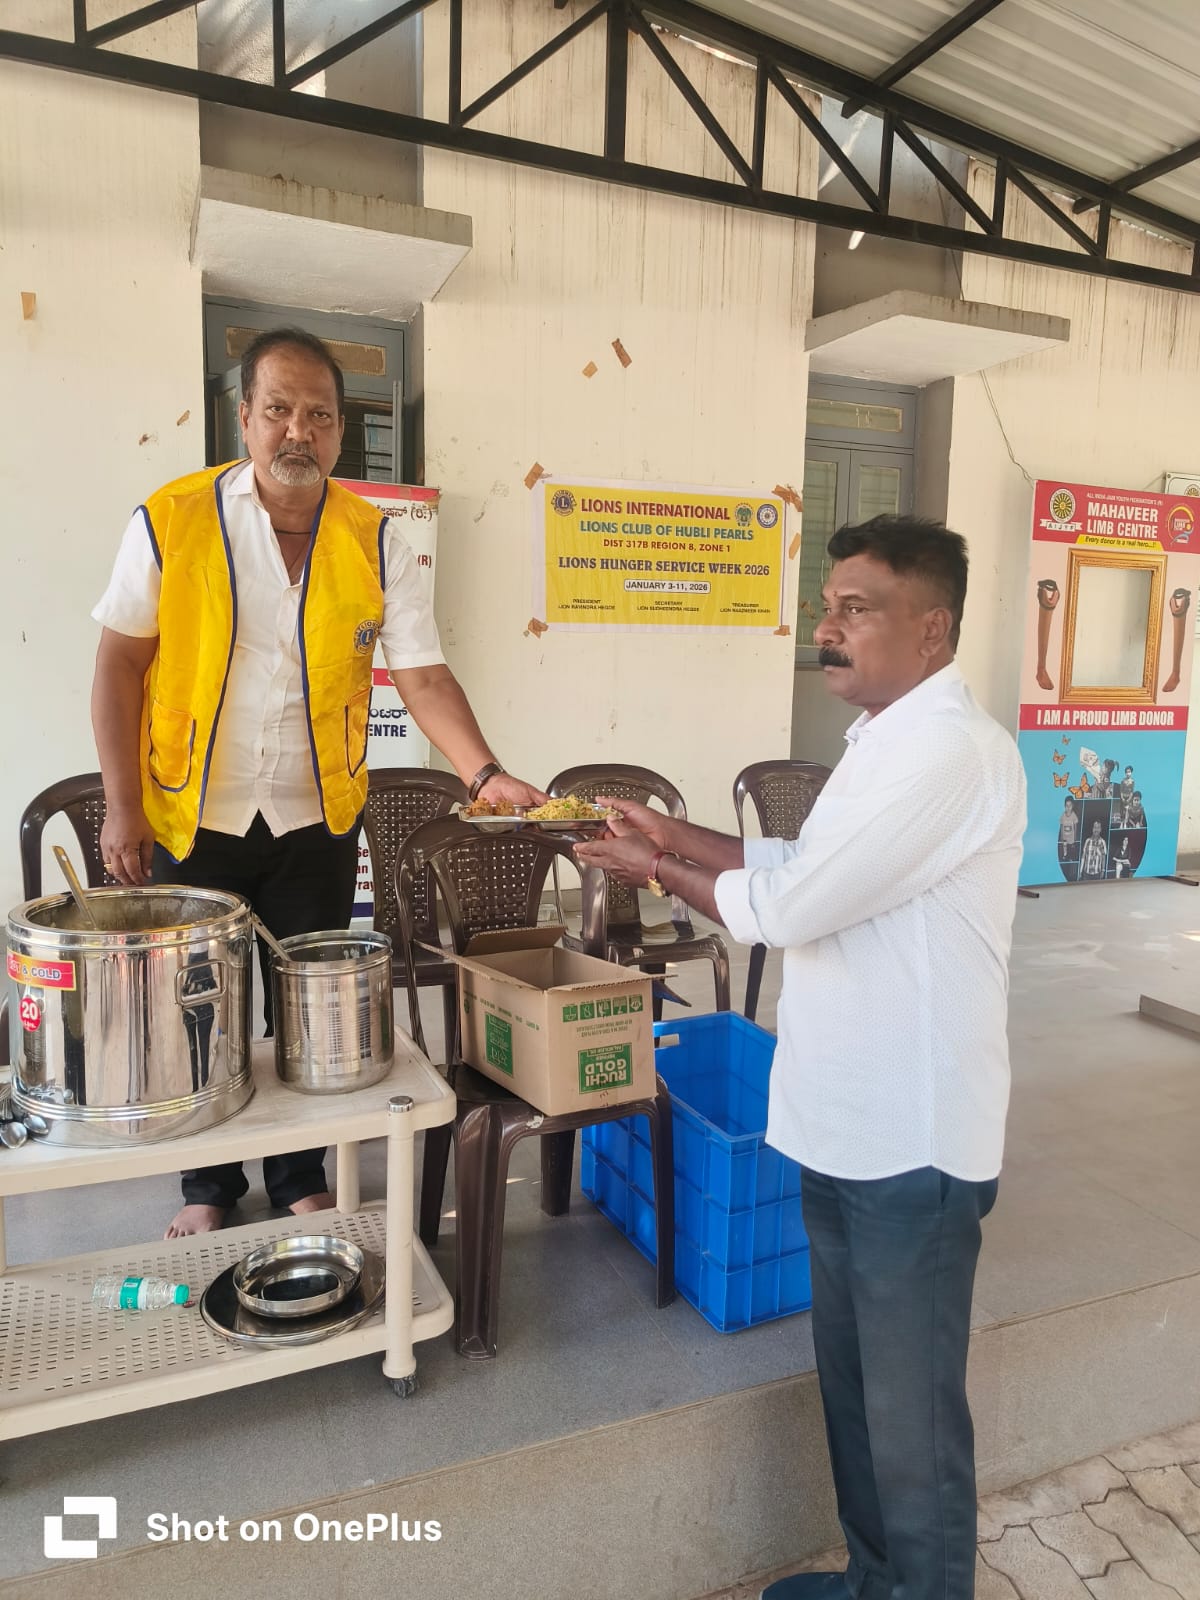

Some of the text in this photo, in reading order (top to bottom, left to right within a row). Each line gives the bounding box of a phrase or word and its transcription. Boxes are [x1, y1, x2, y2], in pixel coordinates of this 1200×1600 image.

[581, 498, 622, 514] LIONS
[626, 501, 730, 520] INTERNATIONAL
[1087, 501, 1159, 523] MAHAVEER
[580, 520, 754, 540] LIONS CLUB OF HUBLI PEARLS
[1087, 519, 1114, 535] LIMB
[1117, 522, 1158, 539] CENTRE
[603, 539, 623, 547] DIST
[626, 540, 648, 549] 317B
[651, 541, 686, 550] REGION
[689, 543, 696, 552] 8,
[699, 544, 723, 552] ZONE
[1085, 536, 1100, 544] Every
[417, 555, 432, 569] (R)
[558, 556, 770, 576] LIONS HUNGER SERVICE WEEK 2026
[626, 581, 708, 591] JANUARY 3-11, 2026
[1036, 709, 1174, 726] I AM A PROUD LIMB DONOR
[369, 724, 407, 737] ENTRE
[31, 967, 61, 980] COLD
[22, 1000, 38, 1020] 20
[585, 1058, 627, 1075] GOLD
[586, 1070, 627, 1087] RUCHI
